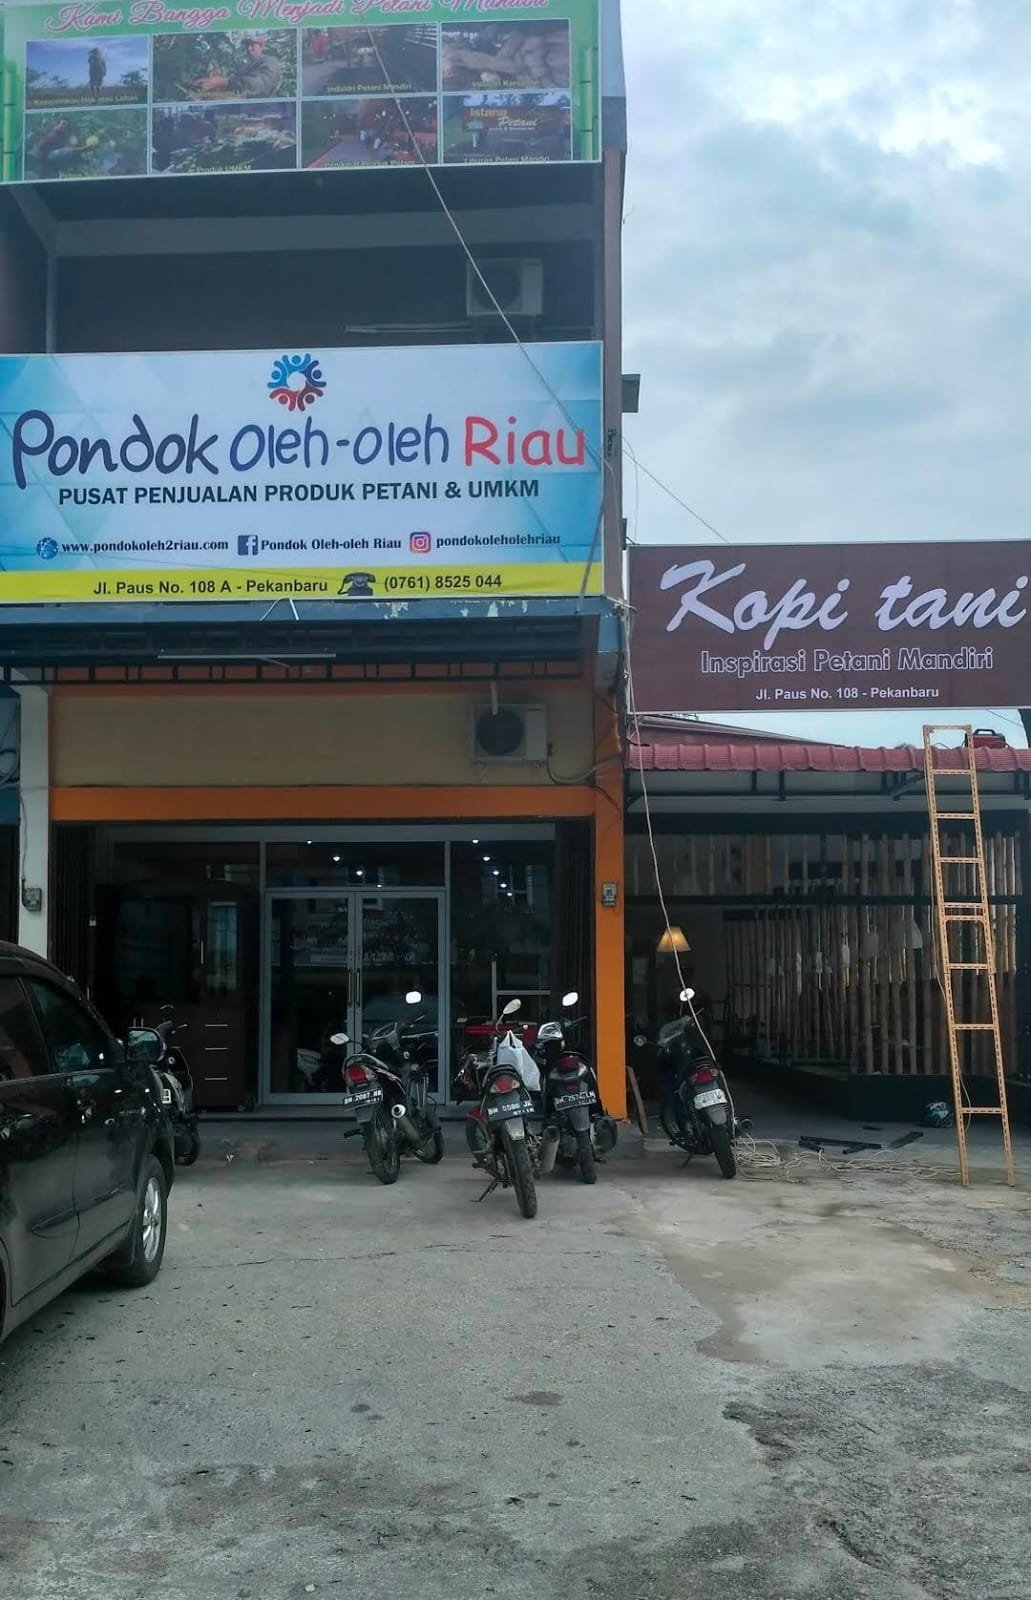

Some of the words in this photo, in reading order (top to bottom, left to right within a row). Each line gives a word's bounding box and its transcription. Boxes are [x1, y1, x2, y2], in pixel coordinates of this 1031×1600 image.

[46, 1, 121, 32] Kami
[130, 1, 229, 28] Bangga
[13, 409, 220, 490] Pondok
[229, 413, 450, 471] Oleh-oleh
[464, 416, 585, 467] Riau
[59, 488, 128, 505] PUSAT
[134, 485, 258, 504] PENJUALAN
[265, 483, 355, 502] PRODUK
[362, 481, 437, 500] PETANI
[445, 481, 462, 499] &
[468, 479, 540, 498] UMKM
[61, 539, 229, 554] www.pondokoleh2riau.com
[261, 538, 307, 550] Pondok
[311, 538, 370, 550] Oleh-oleh
[373, 537, 401, 549] Riau
[436, 533, 561, 549] pondokoleholehriau
[93, 583, 111, 595] Jl.
[116, 581, 154, 594] Paus
[159, 581, 184, 594] No.
[189, 580, 216, 593] 108
[220, 580, 232, 593] A
[246, 578, 328, 592] Pekanbaru
[384, 576, 430, 592] (0761)
[435, 576, 471, 589] 8525
[475, 575, 503, 588] 044
[660, 559, 851, 651] Kopi
[874, 575, 1029, 632] tani
[700, 649, 806, 679] Inspirasi
[814, 647, 891, 672] Petani
[897, 646, 993, 670] Mandiri
[756, 688, 771, 701] Jl.
[775, 688, 807, 700] Paus
[811, 688, 832, 699] No.
[836, 687, 858, 699] 108
[871, 686, 940, 699] Pekanbaru
